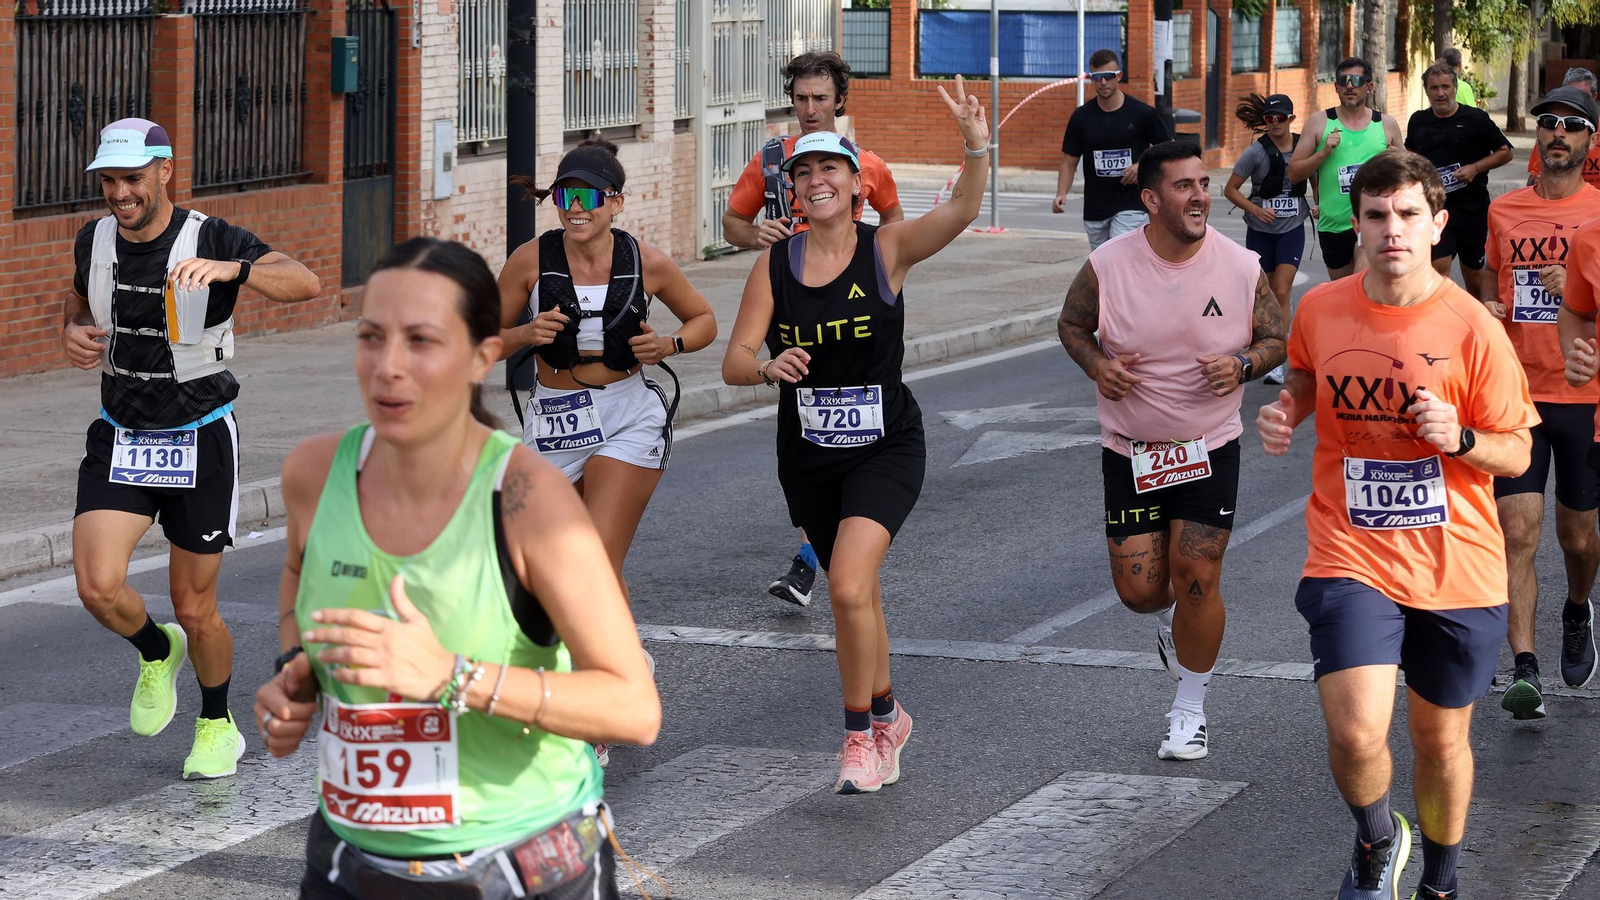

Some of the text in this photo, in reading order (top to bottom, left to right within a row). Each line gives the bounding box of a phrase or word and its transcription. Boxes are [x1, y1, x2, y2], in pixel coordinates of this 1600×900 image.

[1101, 158, 1126, 169] 1079
[1442, 173, 1457, 184] 32
[1268, 198, 1293, 208] 1078
[1536, 310, 1558, 320] MIZ
[778, 315, 872, 347] ELITE
[546, 413, 579, 435] 719
[818, 408, 861, 429] 720
[1336, 411, 1363, 421] MEDIA
[560, 434, 599, 449] MIZUNO
[128, 448, 183, 468] 1130
[1149, 445, 1189, 471] 240
[140, 473, 189, 484] MIZUNO
[1162, 467, 1206, 484] MIZUNO
[1361, 483, 1429, 508] 1040
[1382, 512, 1441, 527] MIZUNO
[340, 746, 412, 789] 159
[352, 801, 446, 823] MIZUNO
